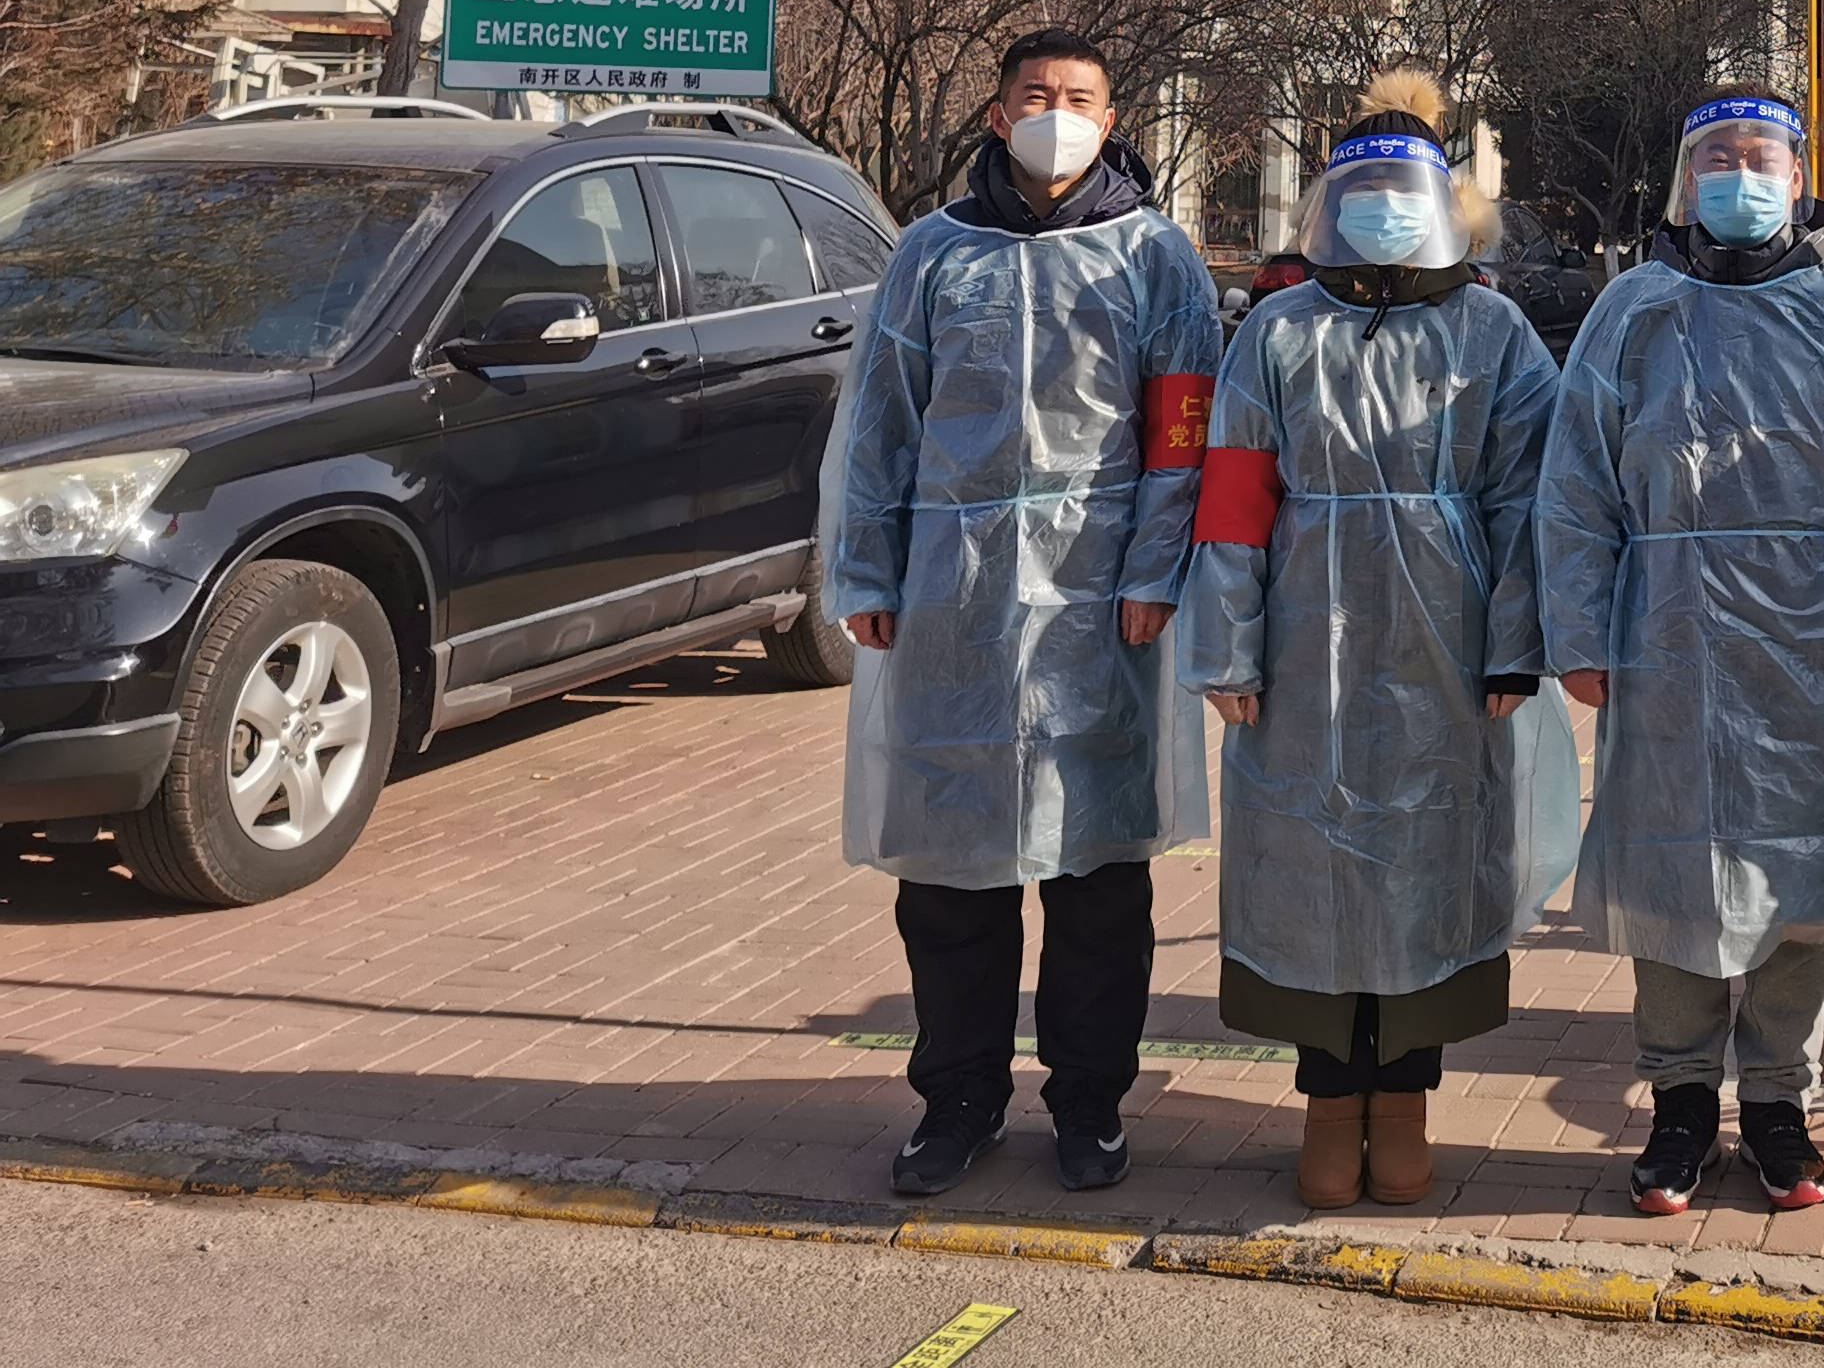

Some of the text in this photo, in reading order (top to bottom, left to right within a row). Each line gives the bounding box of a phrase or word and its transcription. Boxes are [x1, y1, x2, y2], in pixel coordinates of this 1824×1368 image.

[475, 20, 748, 54] EMERGENCY SHELTER
[518, 67, 701, 90] 南开区人民政府 制
[1685, 106, 1718, 130] FACE
[1758, 104, 1801, 131] SHIELD
[1331, 143, 1365, 164] FACE
[1407, 143, 1448, 168] SHIELD
